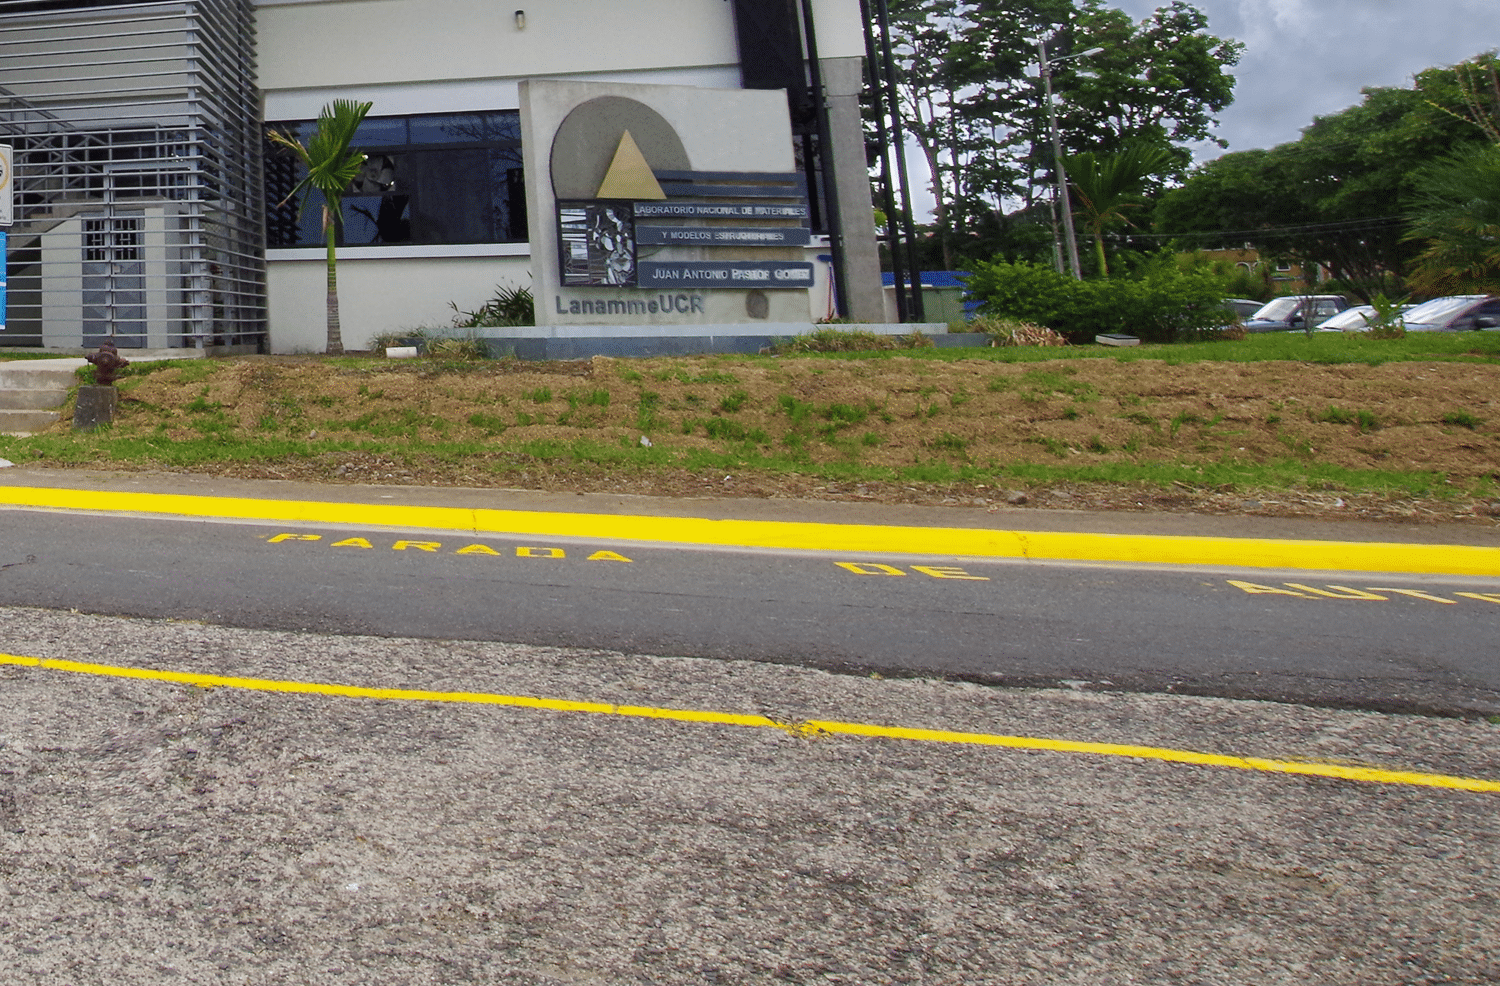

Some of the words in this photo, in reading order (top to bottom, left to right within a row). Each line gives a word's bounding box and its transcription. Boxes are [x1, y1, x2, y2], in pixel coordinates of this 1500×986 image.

[634, 205, 694, 214] LABORATORIO
[697, 206, 738, 215] NACIONAL
[741, 206, 753, 215] DE
[755, 206, 806, 215] MATERIALES
[662, 231, 668, 239] Y
[670, 232, 711, 240] MODELOS
[652, 268, 680, 279] JUAN
[683, 268, 728, 279] ANTONIO
[555, 294, 704, 315] LanammeUCR
[266, 532, 634, 563] PARADA
[833, 561, 991, 581] DE
